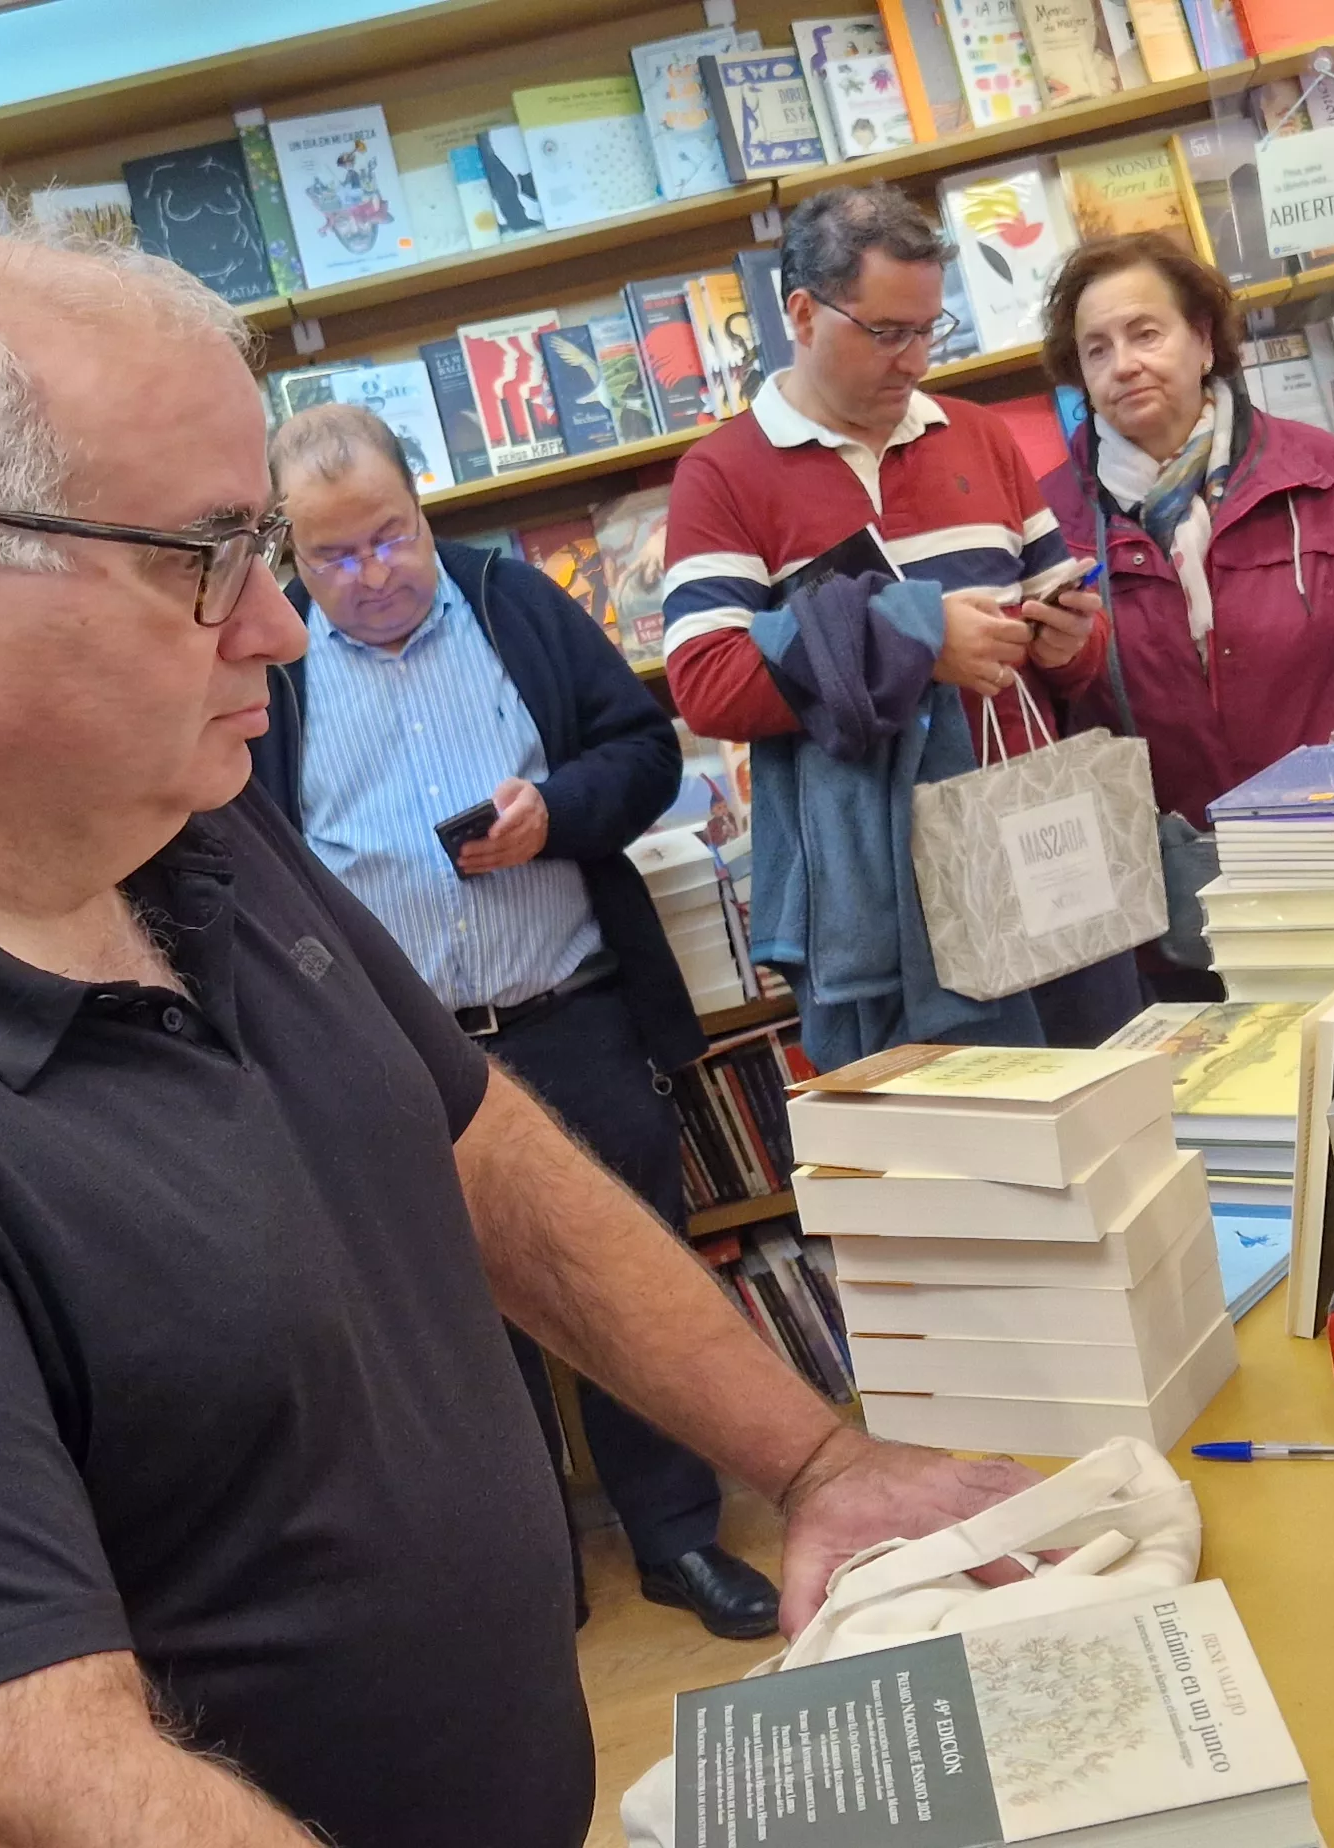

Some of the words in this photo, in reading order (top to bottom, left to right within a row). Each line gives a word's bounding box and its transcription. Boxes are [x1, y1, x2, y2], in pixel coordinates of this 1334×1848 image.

[1153, 1600, 1177, 1618] El
[1158, 1615, 1193, 1673] infinito
[896, 1671, 913, 1702] PREMIO
[1180, 1674, 1201, 1696] en
[1213, 1666, 1247, 1719] VALLEJO
[798, 1710, 809, 1731] PREMIO
[826, 1706, 838, 1728] PREMIO
[844, 1701, 857, 1722] PREMIO
[1189, 1698, 1210, 1722] un
[901, 1703, 920, 1749] NACIONAL
[908, 1750, 922, 1763] DE
[936, 1719, 965, 1775] EDICIÓN
[1188, 1718, 1232, 1774] junco
[910, 1764, 928, 1799] ENSAYO
[916, 1800, 931, 1821] 2020
